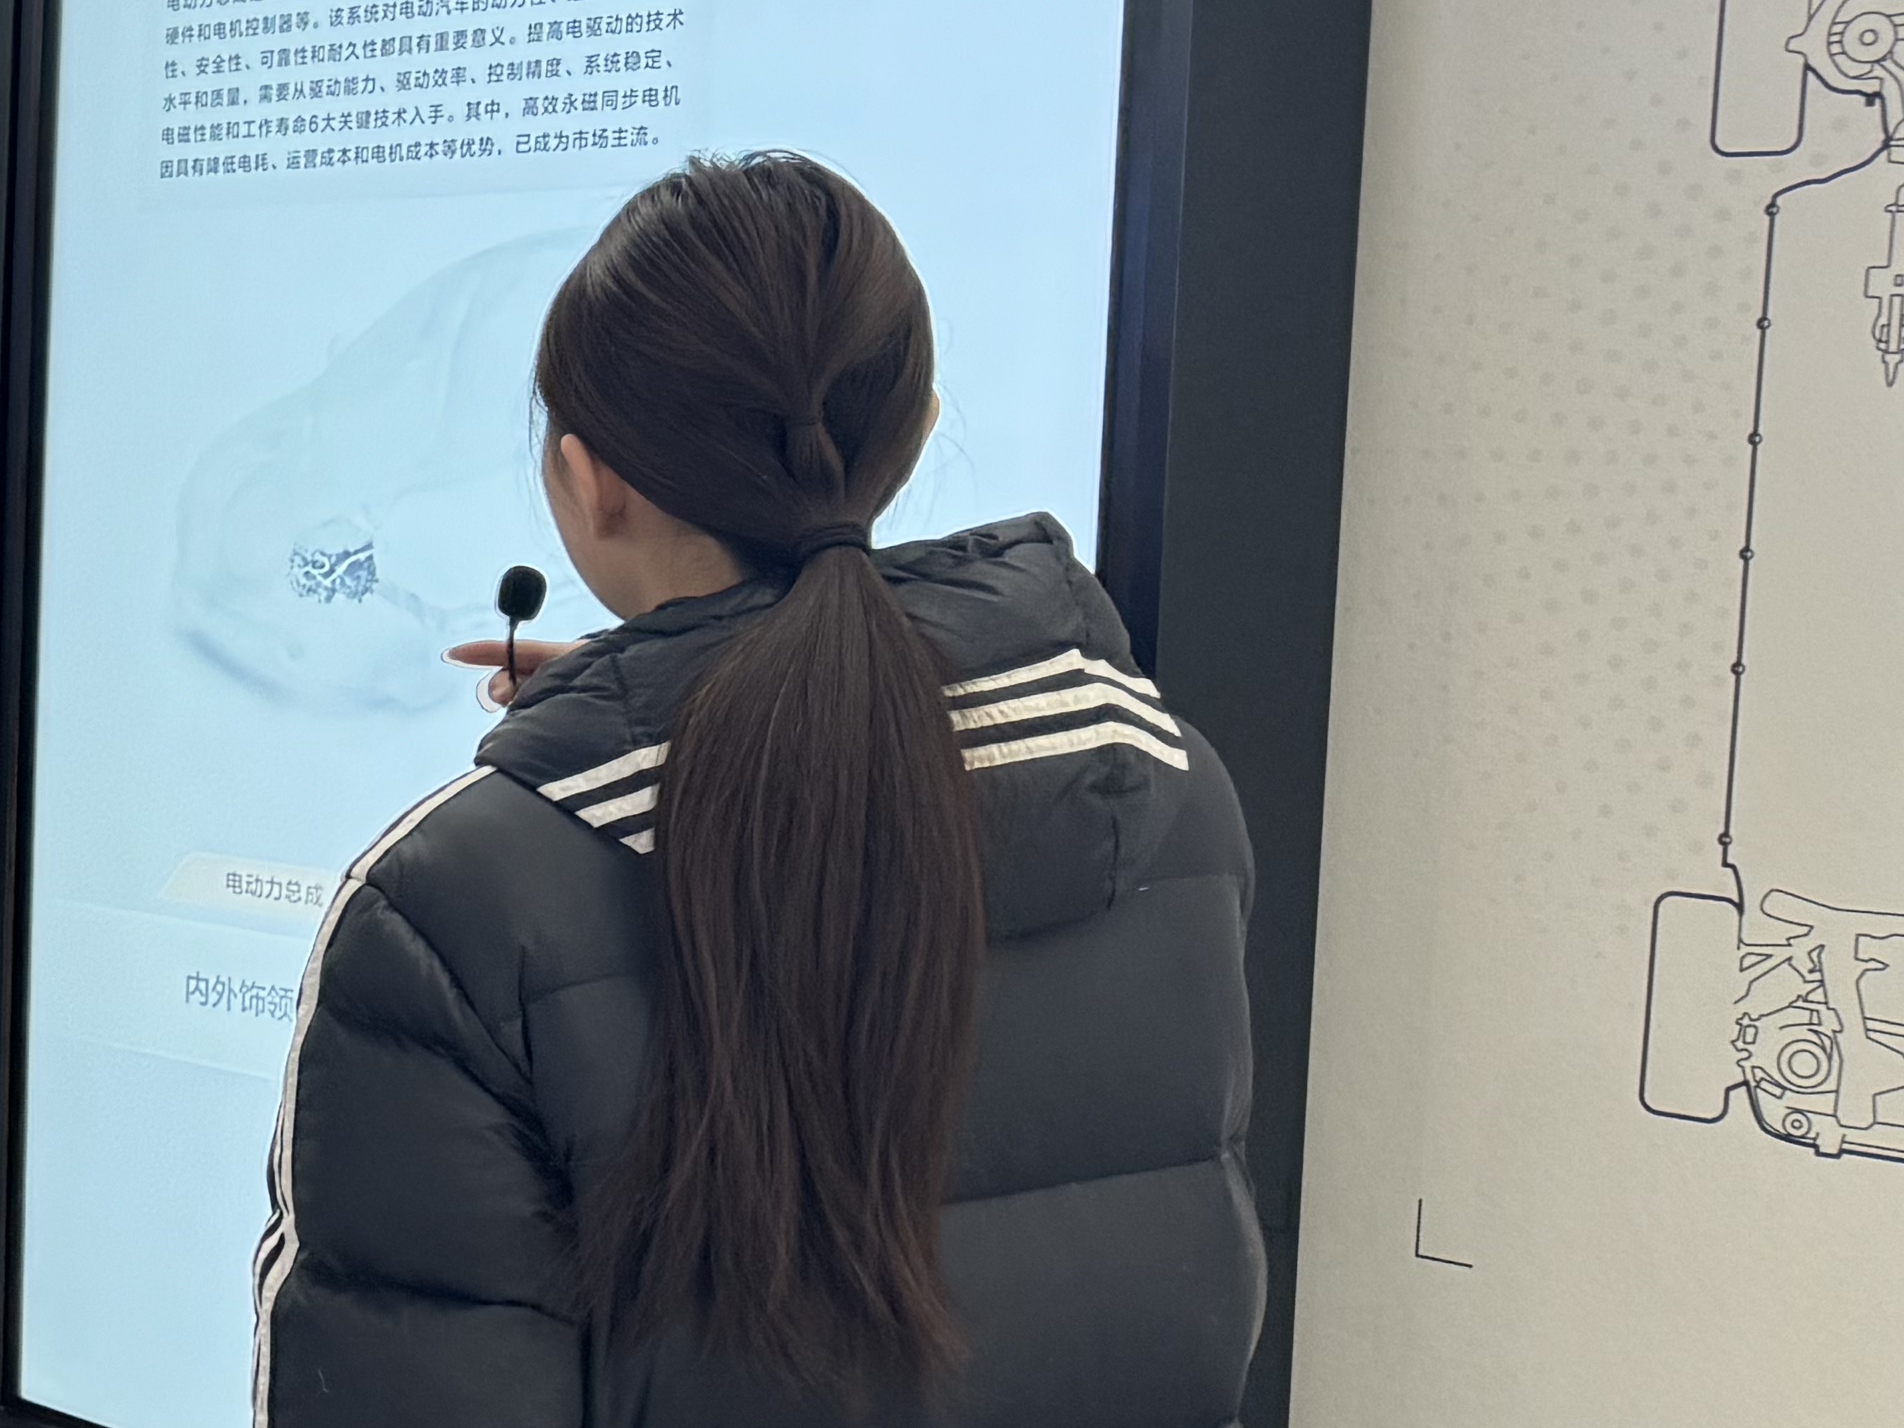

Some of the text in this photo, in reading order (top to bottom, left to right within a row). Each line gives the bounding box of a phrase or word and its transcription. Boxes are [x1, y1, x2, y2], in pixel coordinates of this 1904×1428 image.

[225, 871, 324, 908] 电动力总成
